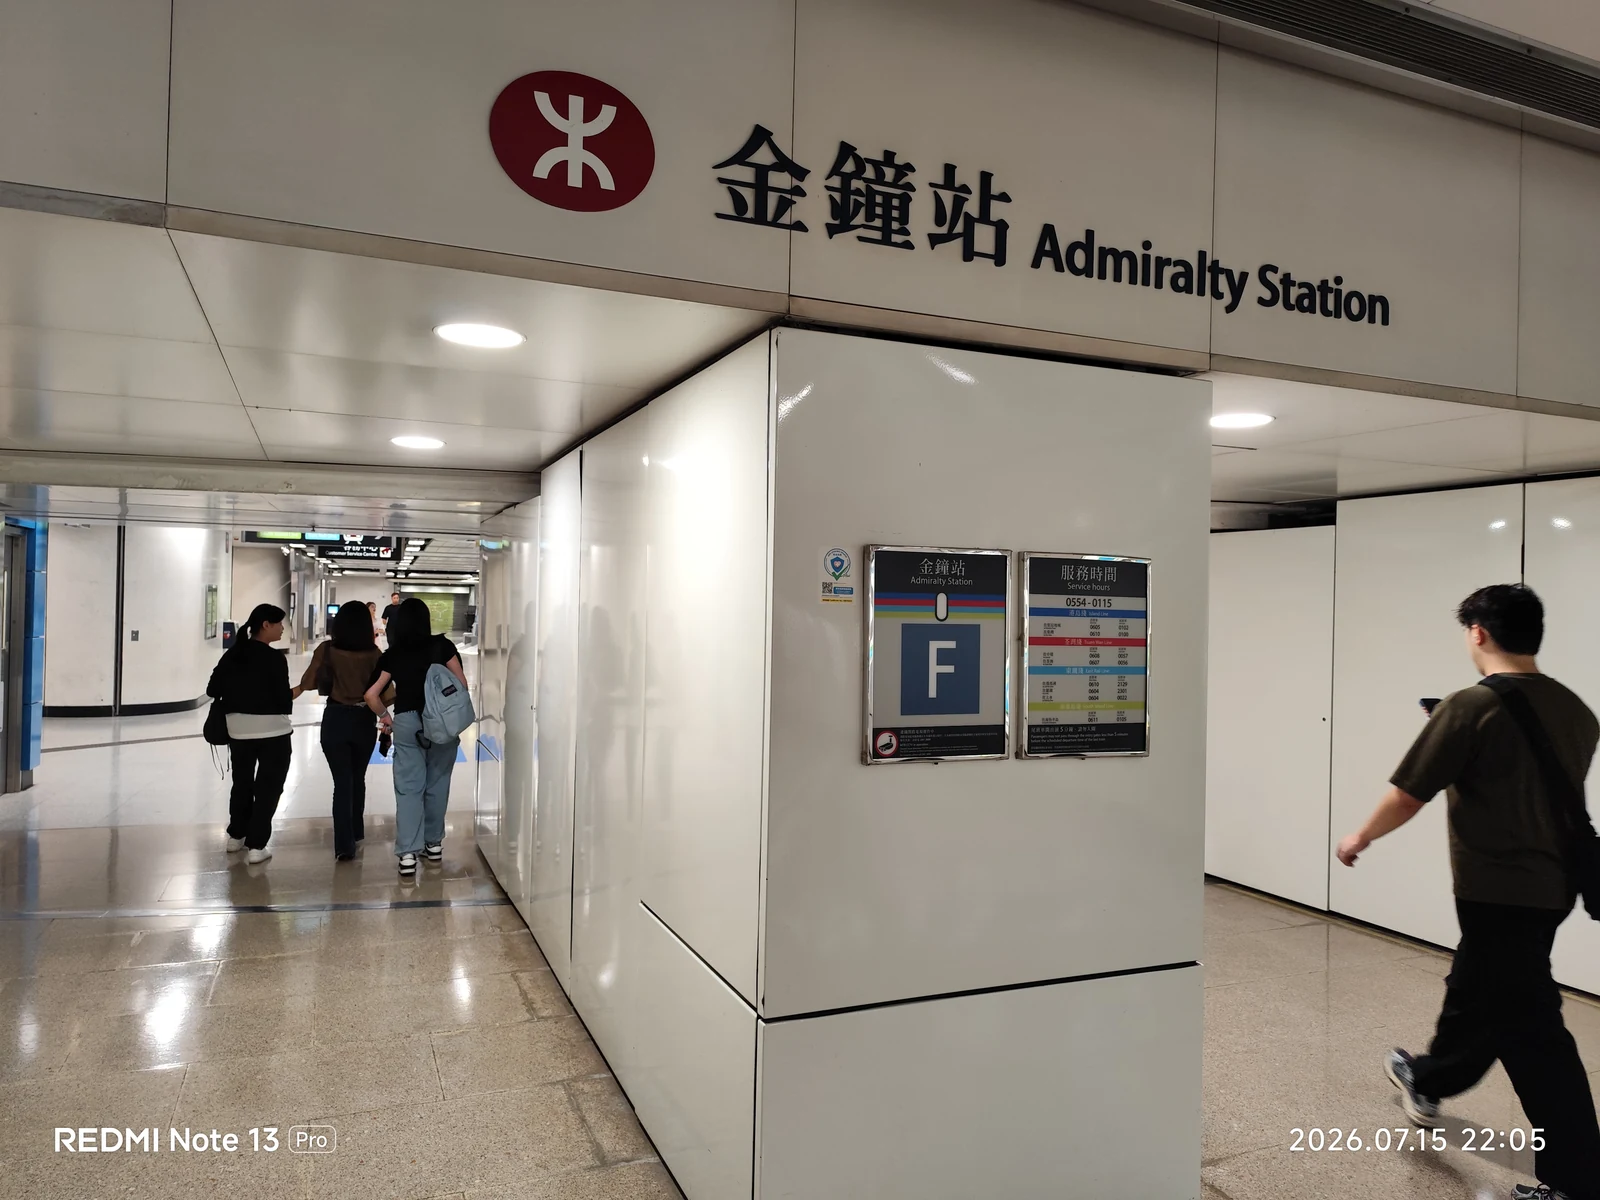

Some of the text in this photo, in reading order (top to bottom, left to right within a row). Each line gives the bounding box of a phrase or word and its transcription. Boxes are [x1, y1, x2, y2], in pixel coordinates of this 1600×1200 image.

[711, 123, 1012, 268] 金鐘站
[1030, 223, 1391, 328] Admiralty Station
[919, 558, 965, 576] 金鐘站
[1060, 564, 1116, 582] 服務時間
[910, 576, 973, 586] Admiralty Station
[1068, 582, 1110, 591] Service hours
[928, 640, 956, 698] F
